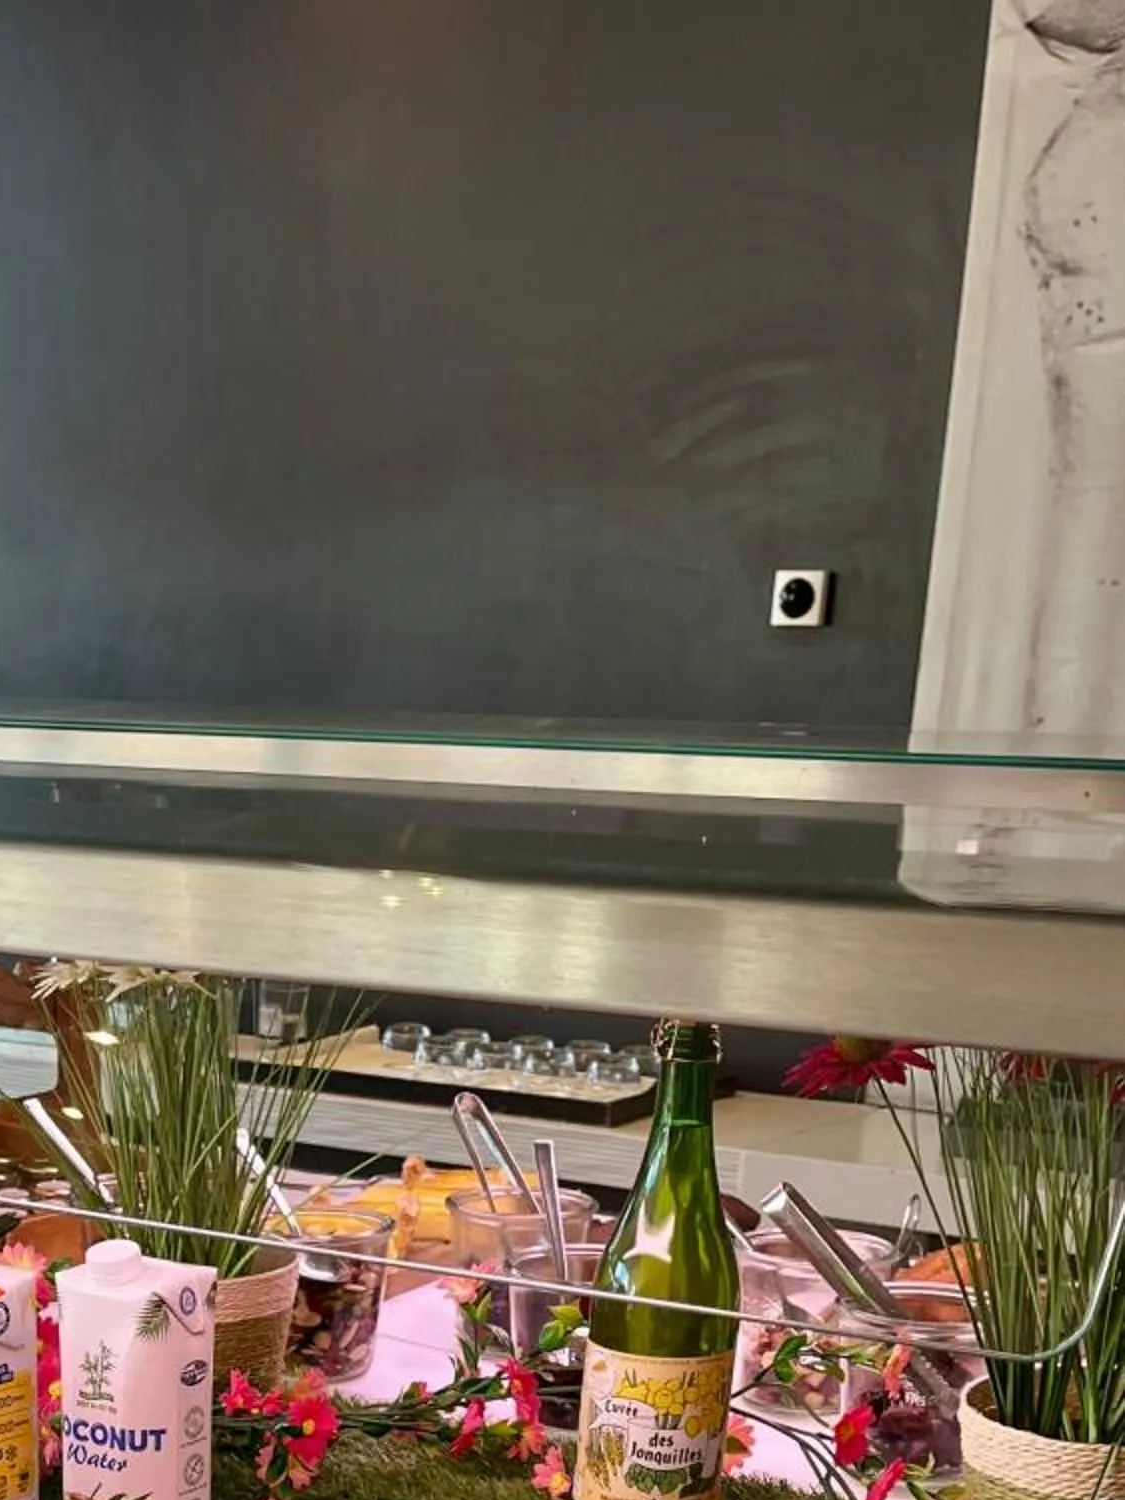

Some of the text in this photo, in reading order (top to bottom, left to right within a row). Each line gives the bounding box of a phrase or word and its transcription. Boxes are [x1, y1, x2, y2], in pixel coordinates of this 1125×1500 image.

[63, 1414, 167, 1453] OCONUT
[649, 1431, 674, 1448] des
[67, 1442, 128, 1473] Water
[631, 1442, 704, 1467] Jonquilles
